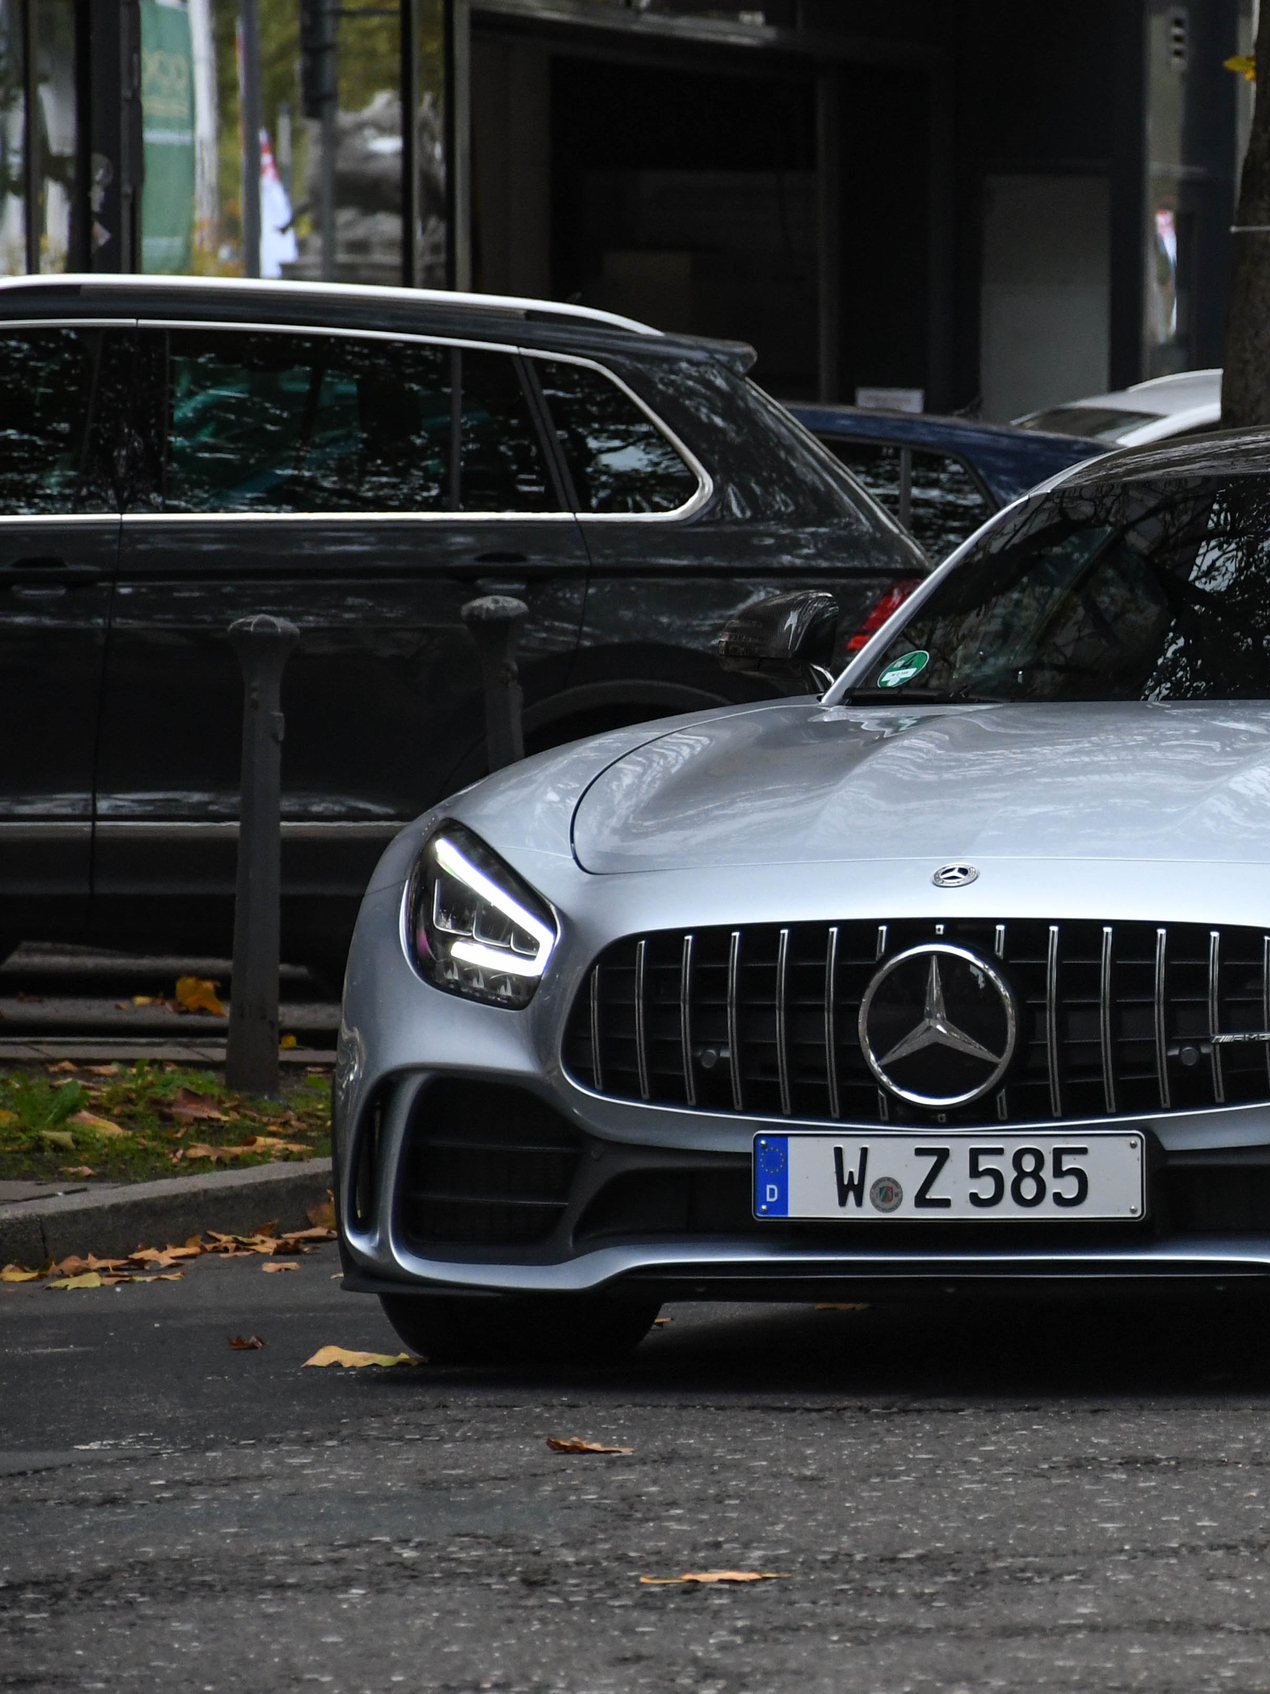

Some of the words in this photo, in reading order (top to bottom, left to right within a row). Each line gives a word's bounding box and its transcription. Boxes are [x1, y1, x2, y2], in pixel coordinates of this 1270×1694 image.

[766, 1184, 778, 1202] D
[834, 1147, 868, 1207] W
[914, 1148, 951, 1208] Z
[969, 1147, 1088, 1208] 585
